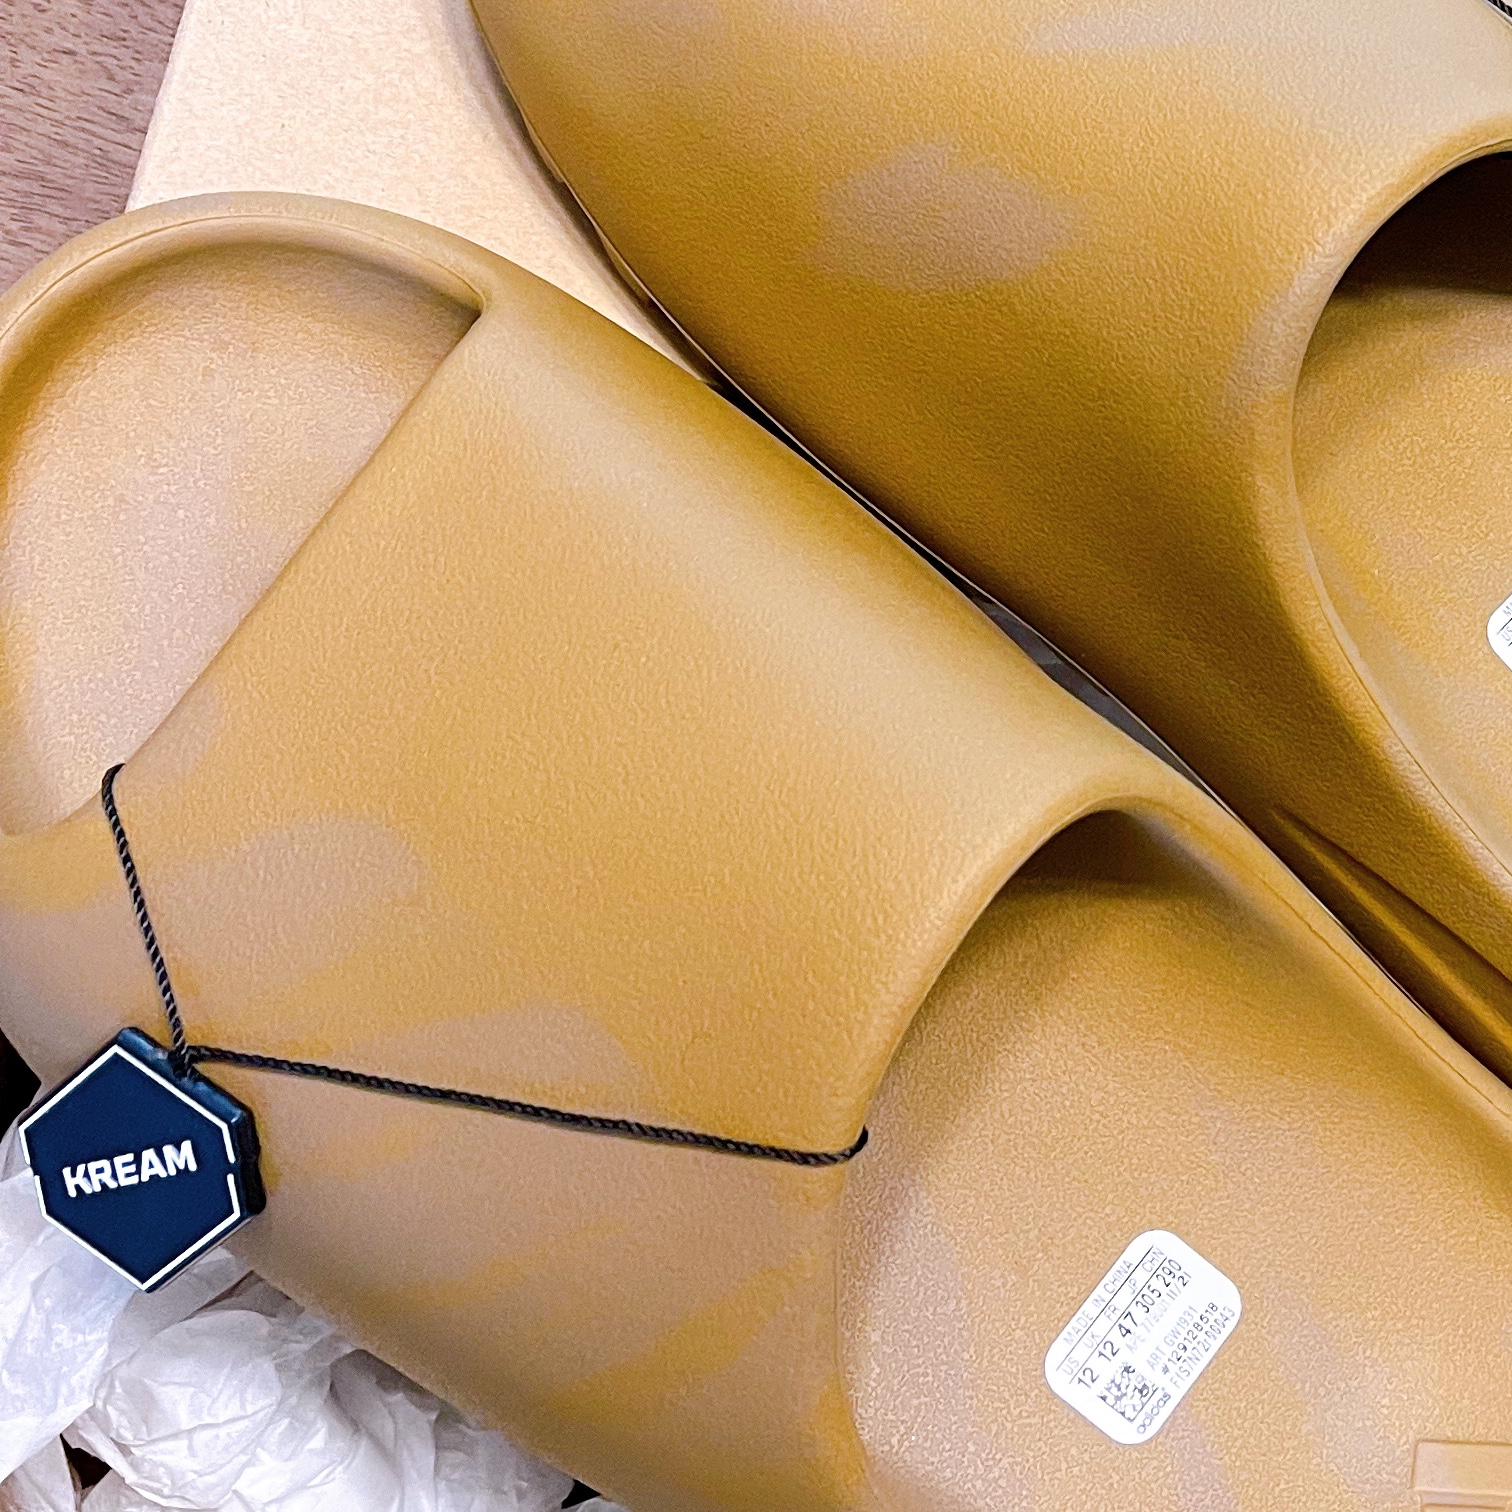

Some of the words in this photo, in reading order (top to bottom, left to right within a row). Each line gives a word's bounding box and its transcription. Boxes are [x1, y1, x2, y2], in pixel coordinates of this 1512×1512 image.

[62, 1140, 198, 1198] KREAM
[1061, 1355, 1080, 1376] US
[1082, 1330, 1101, 1349] UK
[1102, 1303, 1120, 1321] FR
[1127, 1277, 1138, 1295] JP
[1140, 1246, 1165, 1273] CHN
[1062, 1309, 1093, 1345] MADE
[1090, 1293, 1106, 1309] IN
[1102, 1259, 1133, 1294] CHINA
[1076, 1366, 1100, 1388] 12
[1097, 1339, 1120, 1362] 12
[1117, 1310, 1138, 1338] 47
[1134, 1283, 1162, 1314] 305
[1155, 1258, 1182, 1288] 290
[1145, 1344, 1166, 1371] ART
[1162, 1304, 1198, 1347] GW1931
